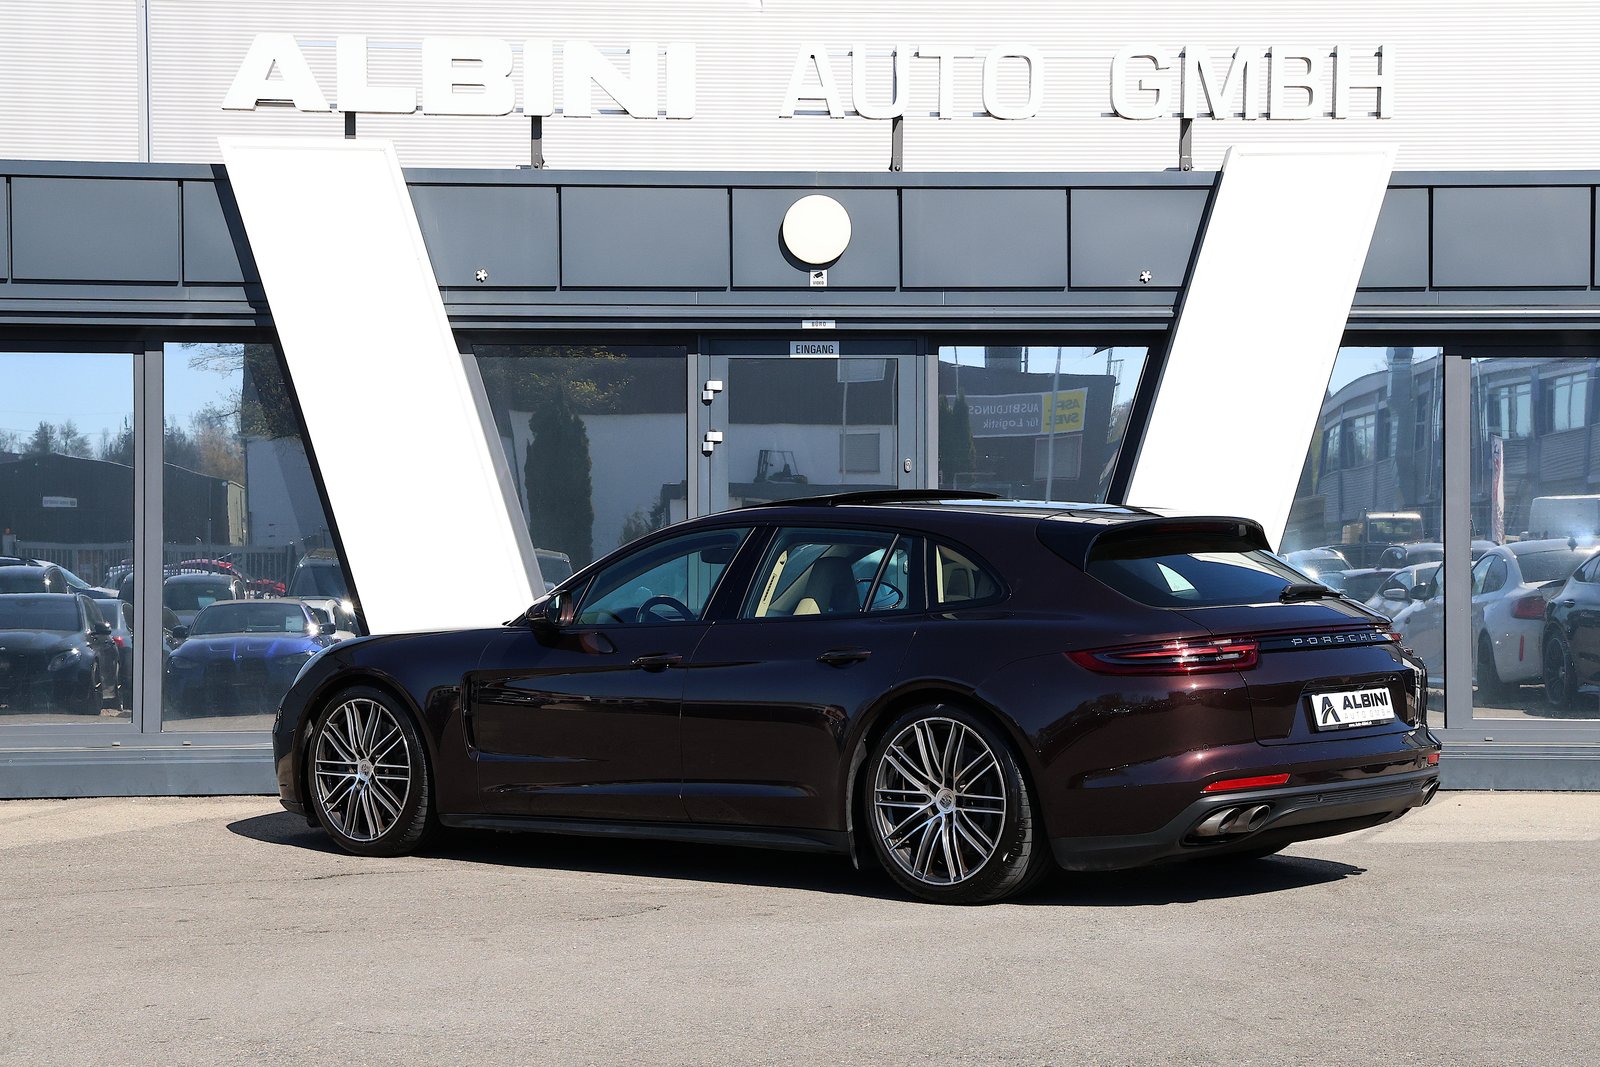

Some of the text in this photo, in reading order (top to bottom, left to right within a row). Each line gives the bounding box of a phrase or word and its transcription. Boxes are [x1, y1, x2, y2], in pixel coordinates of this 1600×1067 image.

[221, 33, 1395, 120] ALBINI AUTO GMBH
[795, 344, 834, 354] EINGANG
[1291, 633, 1377, 646] PORSCHE
[1342, 692, 1389, 710] ALBINI
[1344, 710, 1367, 720] AUTO
